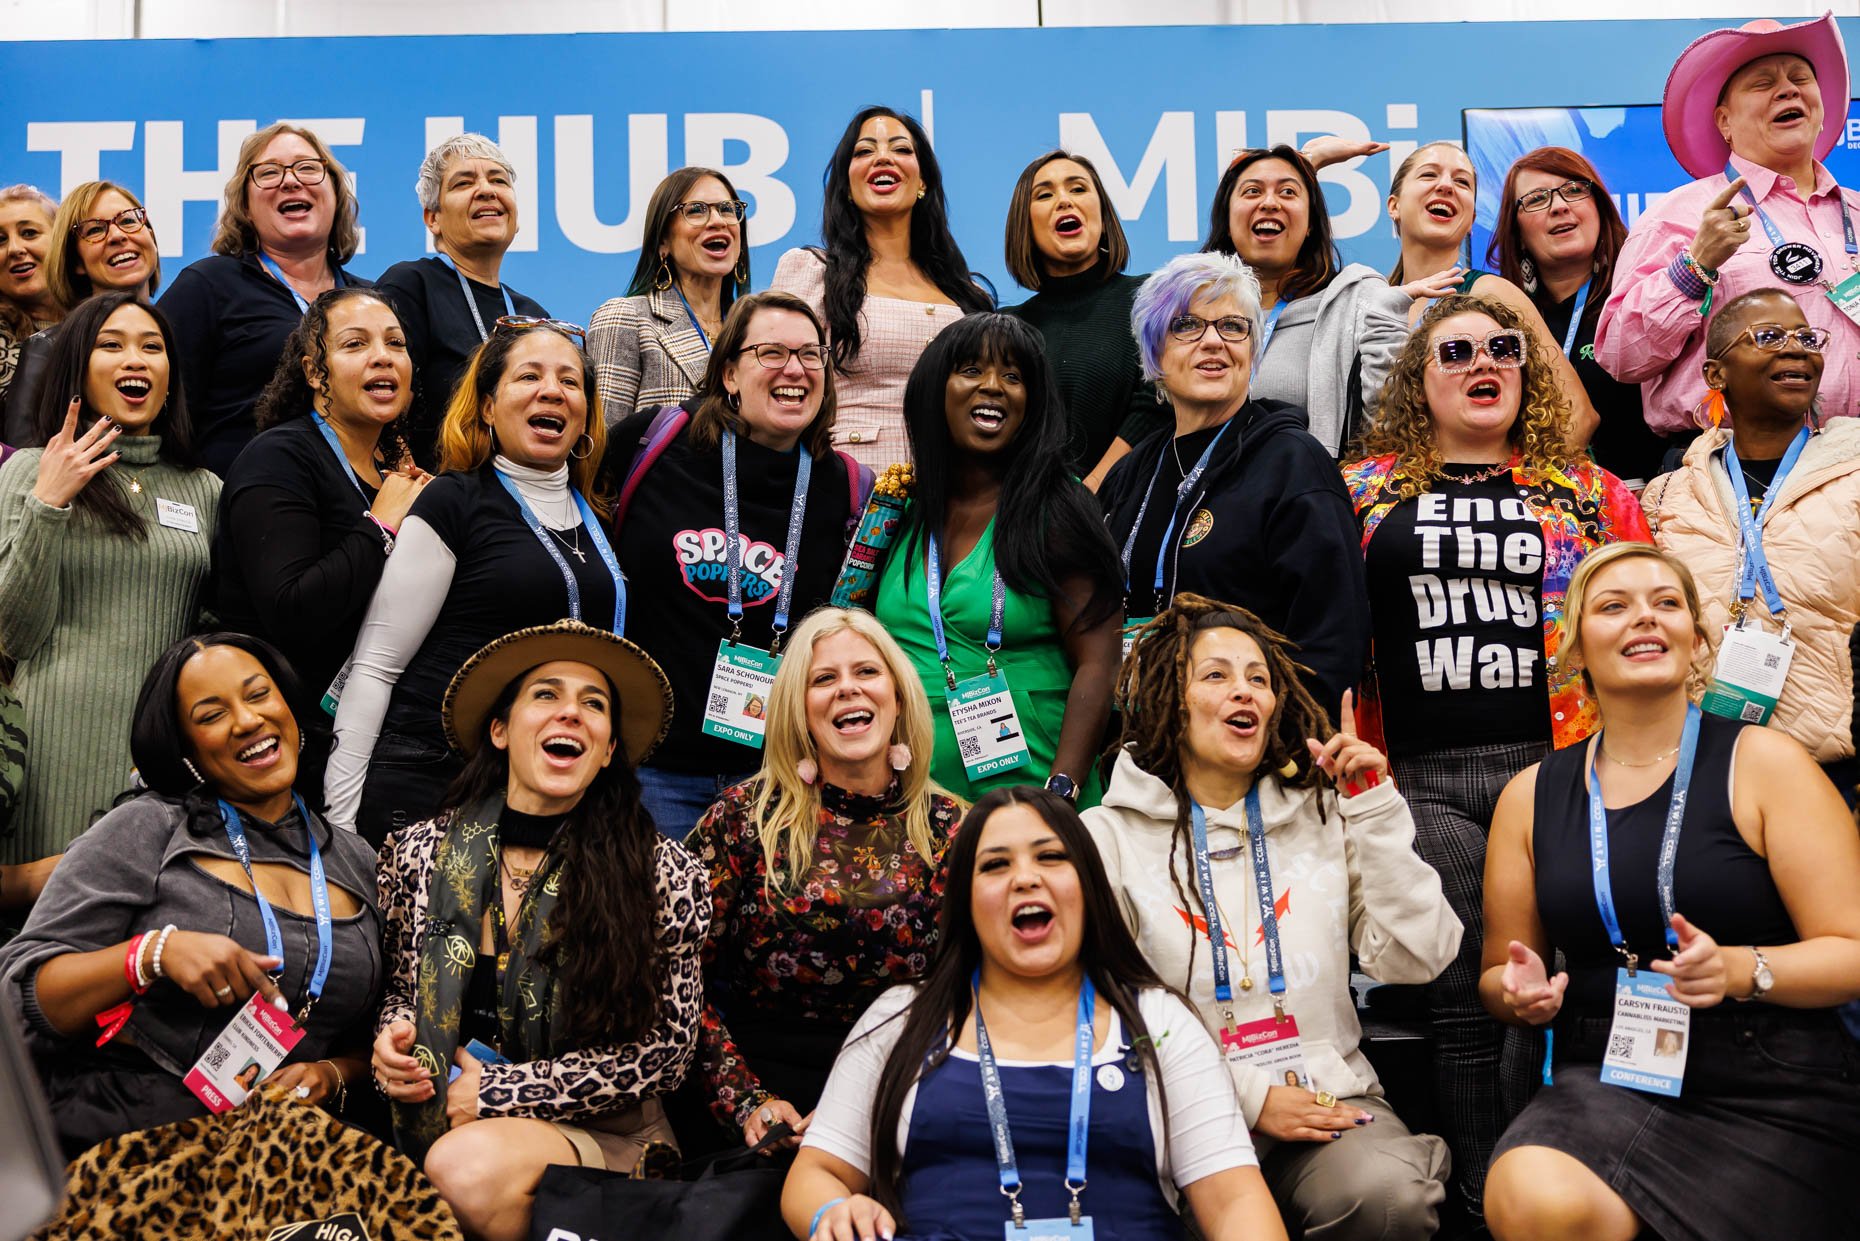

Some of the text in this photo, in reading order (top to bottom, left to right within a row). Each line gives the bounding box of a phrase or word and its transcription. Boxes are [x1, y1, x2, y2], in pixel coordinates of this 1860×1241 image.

[425, 113, 796, 254] HUB
[1414, 526, 1542, 574] The
[684, 563, 774, 600] POPRS!
[1408, 574, 1537, 629] Drug
[718, 664, 735, 675] SARA
[1415, 636, 1538, 691] War
[715, 674, 729, 682] SPACE
[952, 697, 1002, 717] ETYSHA MIXON
[977, 709, 997, 719] BRANDS
[713, 724, 754, 742] EXPO ONLY
[977, 761, 998, 774] EXPO
[1000, 755, 1019, 767] ONLY
[1257, 835, 1265, 864] CCELL
[1207, 902, 1217, 929] CCELL
[1216, 946, 1225, 981] MJBizCon
[1269, 938, 1277, 972] MJBizCon
[1618, 999, 1688, 1016] CARSYN FRAUSTO
[240, 1014, 284, 1060] ERIKKA FORTENBERRY
[1610, 1069, 1672, 1089] CONFERENCE
[201, 1085, 222, 1107] PRESS
[315, 1223, 359, 1241] HIG
